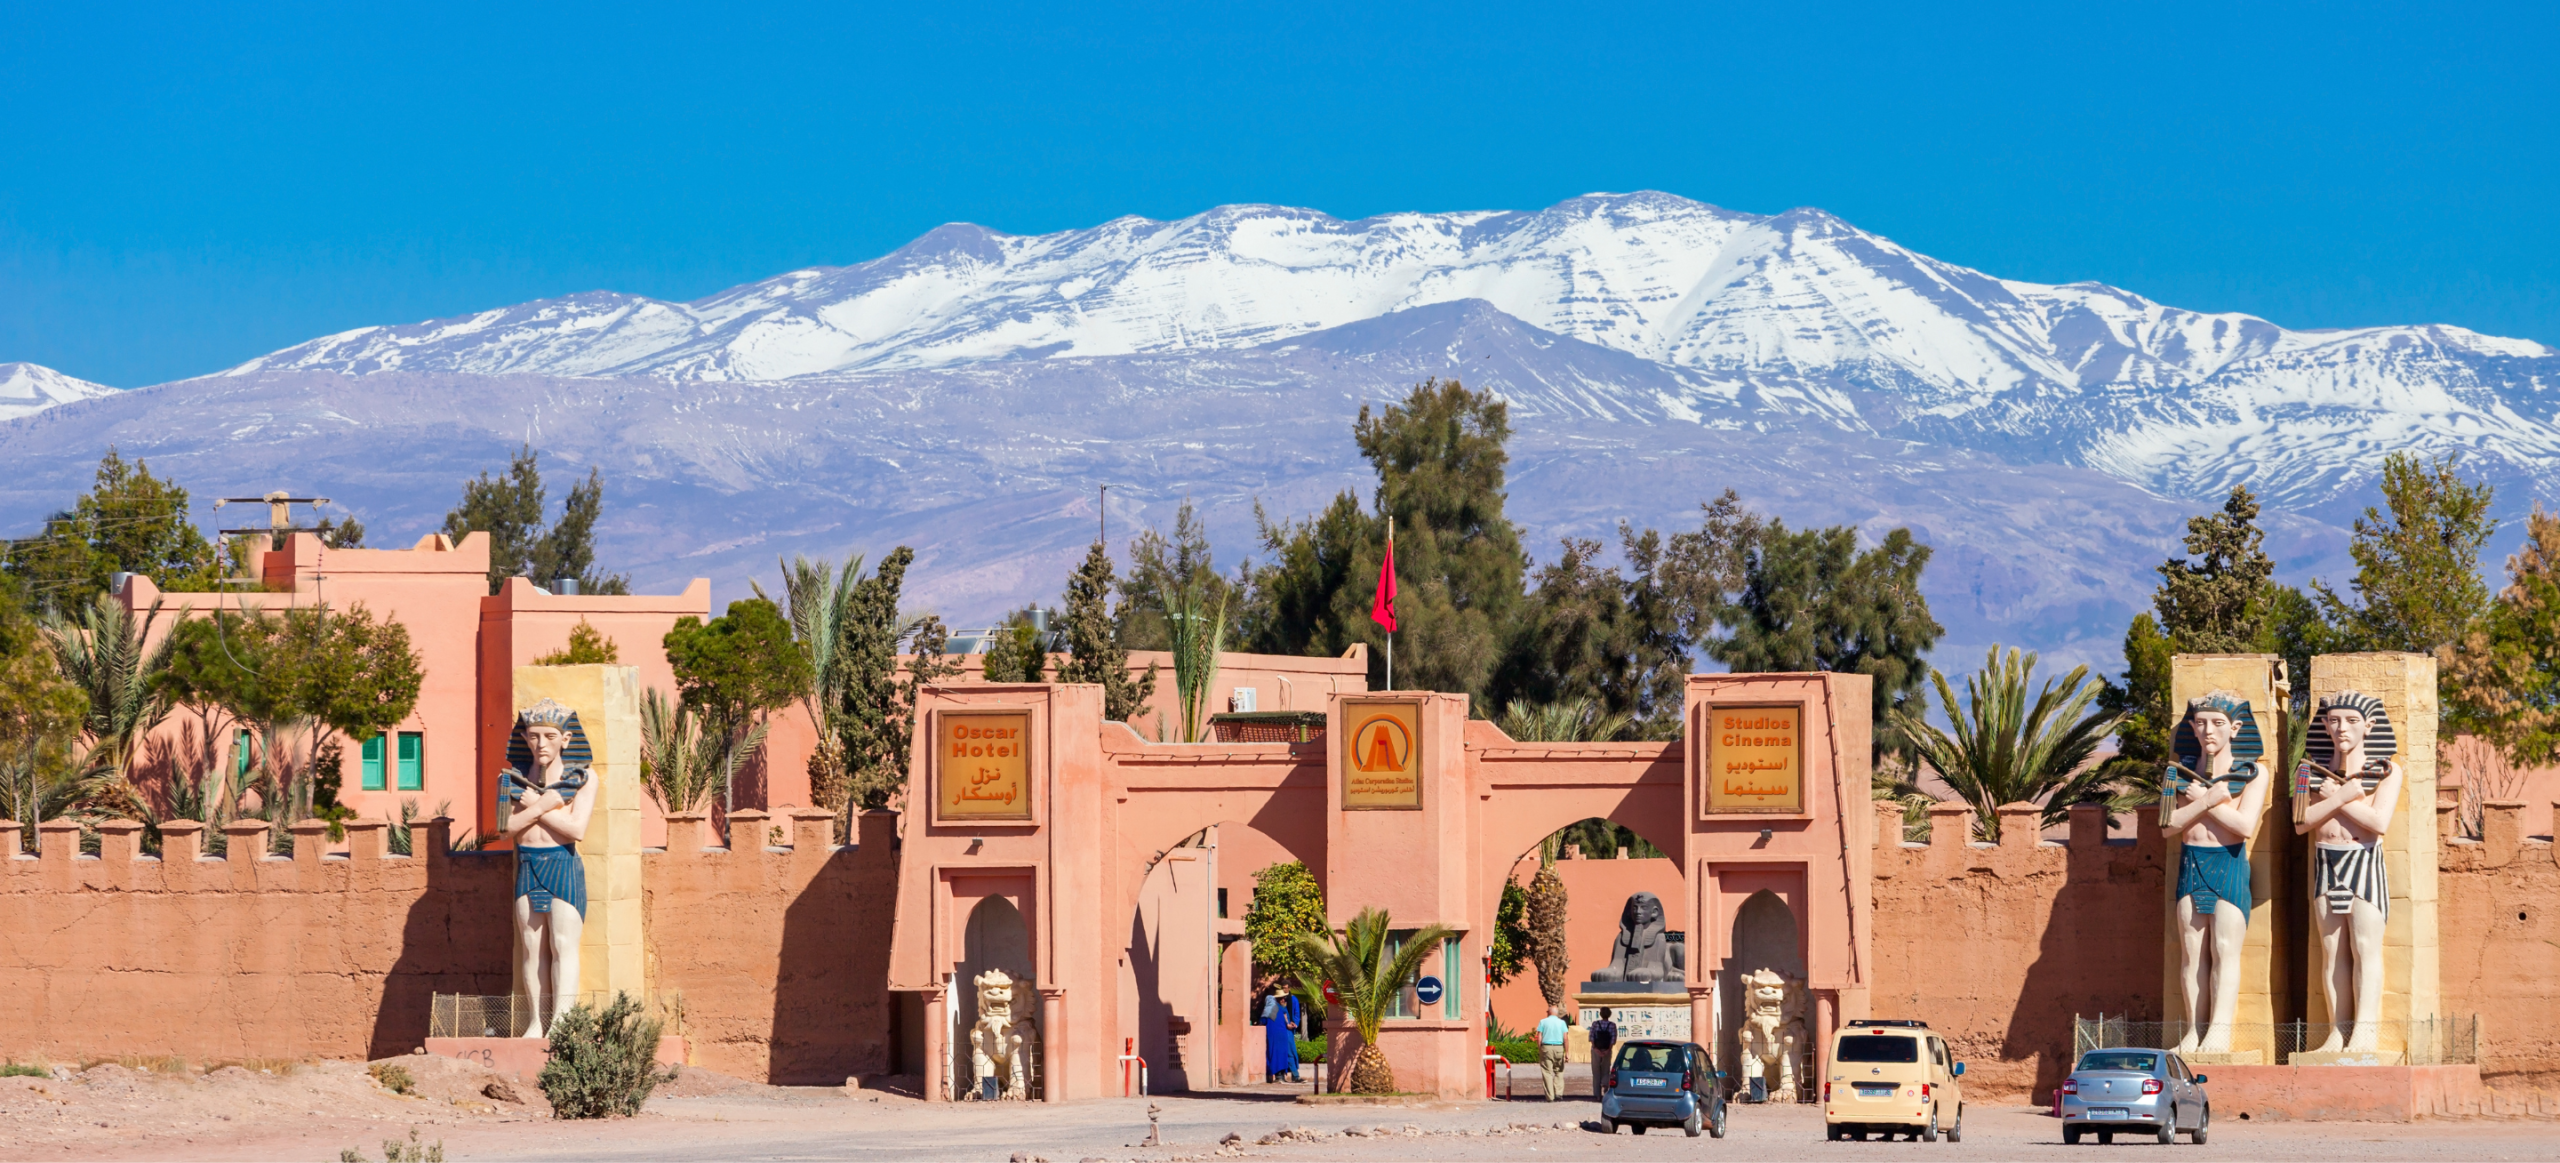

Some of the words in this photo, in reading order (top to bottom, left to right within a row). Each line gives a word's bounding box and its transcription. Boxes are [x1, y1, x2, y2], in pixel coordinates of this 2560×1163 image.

[1723, 716, 1791, 730] Studios
[953, 724, 1018, 739] Oscar
[1722, 733, 1791, 747] Cinema
[952, 742, 1018, 758] Hotel
[1725, 757, 1788, 774] استوديو
[971, 767, 1001, 785] نزل
[952, 782, 1018, 805] أوسكار
[1723, 779, 1789, 801] سينما
